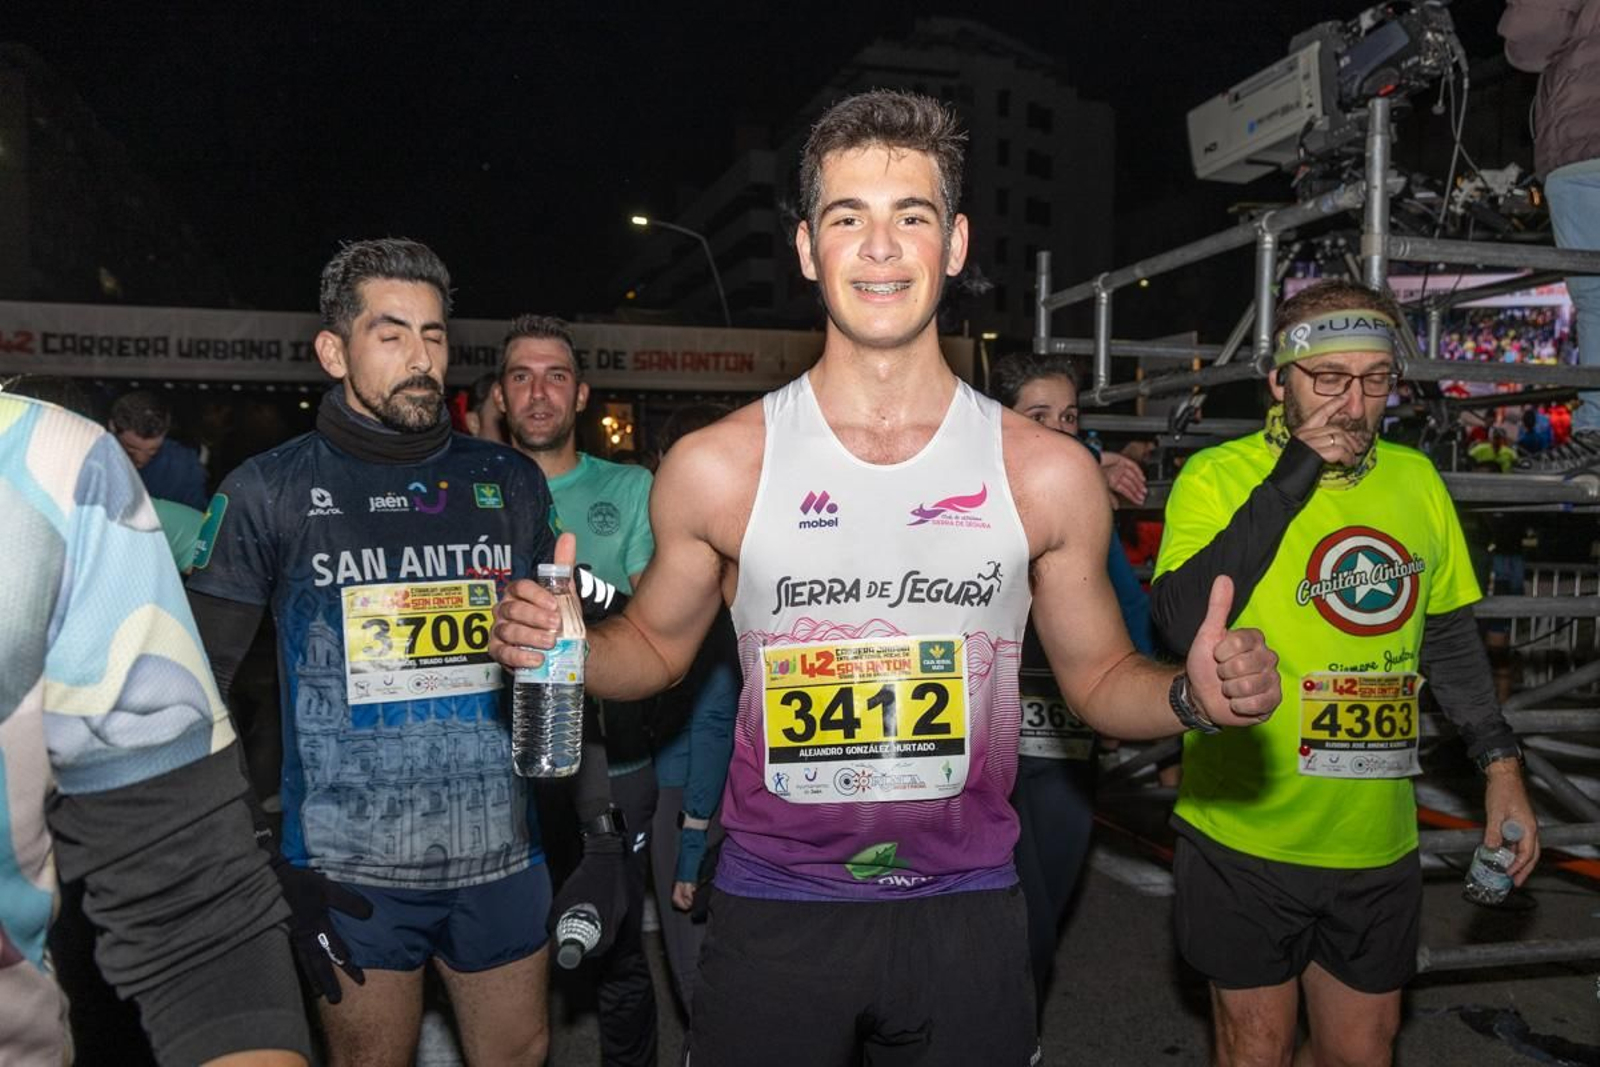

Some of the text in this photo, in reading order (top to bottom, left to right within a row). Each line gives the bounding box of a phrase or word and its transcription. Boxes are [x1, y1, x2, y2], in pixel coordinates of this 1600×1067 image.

[42, 331, 170, 357] CARRERA
[178, 338, 283, 361] URBANA
[596, 350, 627, 370] DE
[633, 351, 677, 371] SAN
[682, 352, 755, 373] ANTON
[798, 516, 838, 529] mobel
[311, 547, 388, 587] SAN
[399, 535, 512, 579] ANTÓN
[772, 570, 994, 615] SIERRA DE SEGURA
[361, 612, 489, 657] 3706
[800, 650, 835, 678] 42
[836, 661, 863, 675] SAN
[866, 658, 911, 673] ANTON
[1332, 678, 1358, 696] 42
[780, 682, 952, 743] 3412
[1311, 702, 1412, 738] 4363
[799, 742, 935, 757] ALEJANDRO GONZÁLEZ HURTADO
